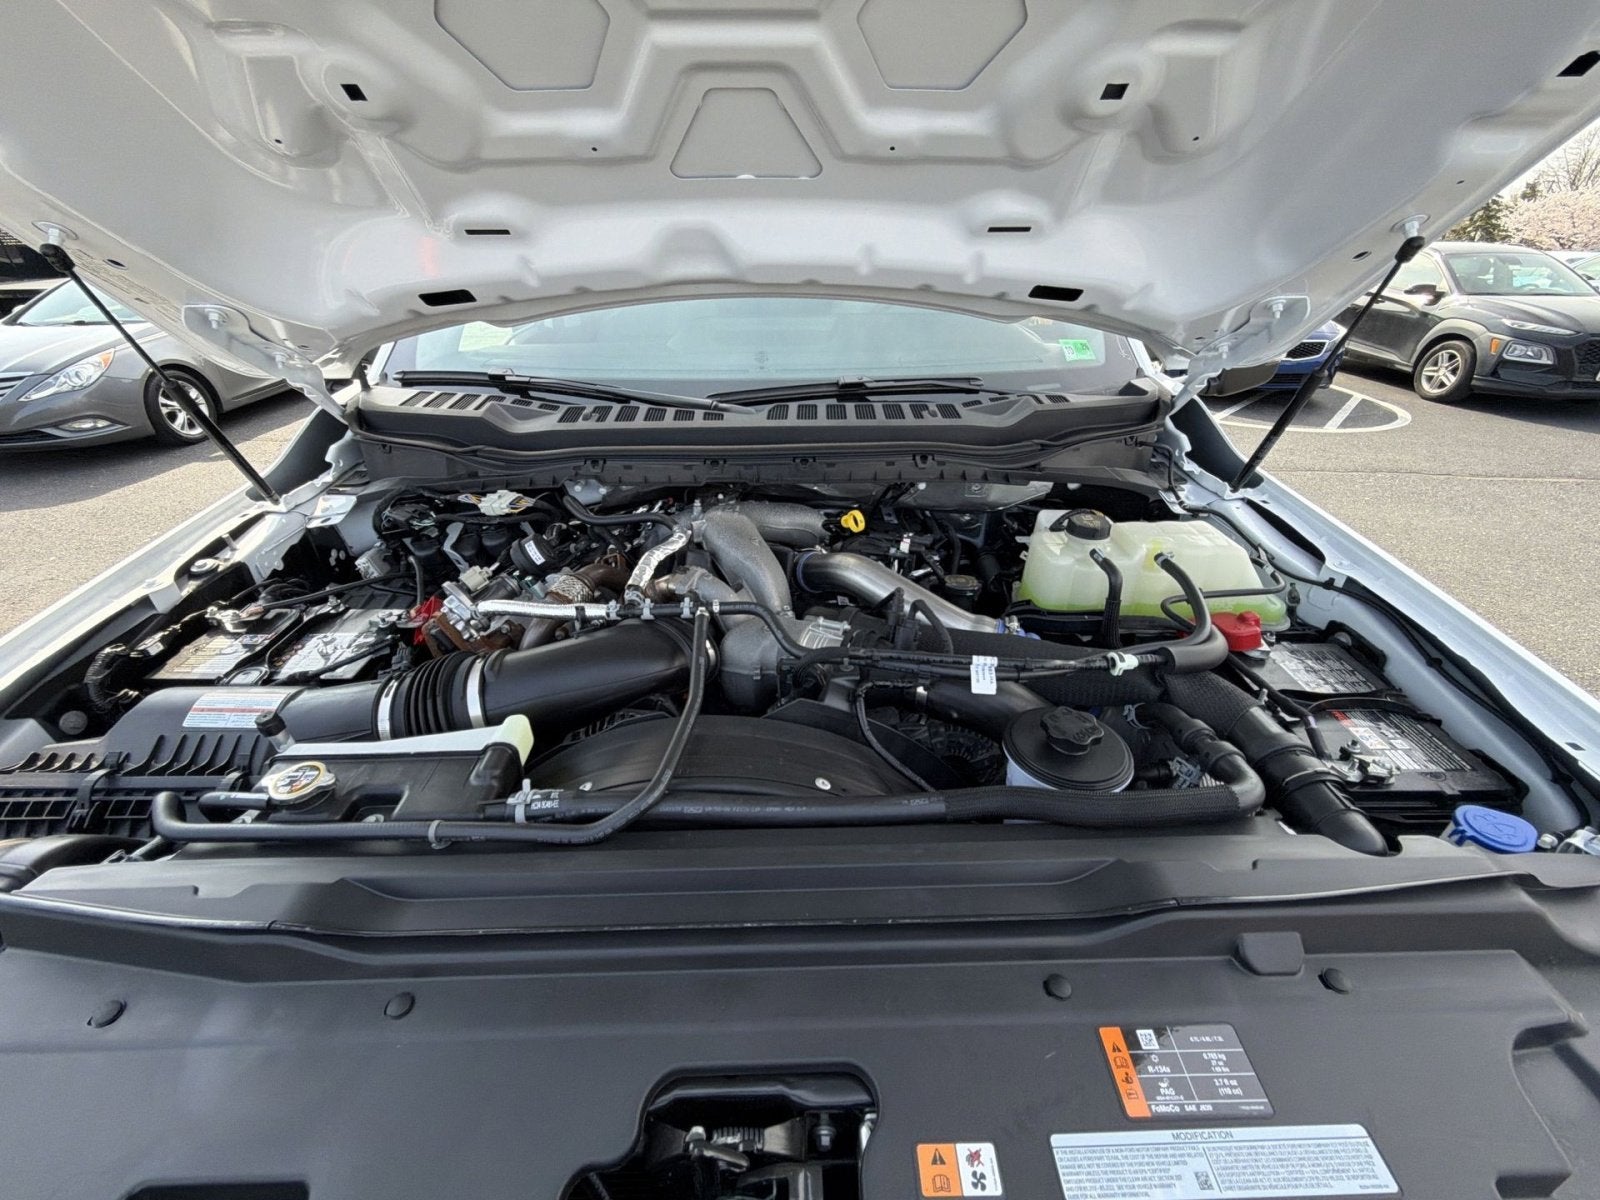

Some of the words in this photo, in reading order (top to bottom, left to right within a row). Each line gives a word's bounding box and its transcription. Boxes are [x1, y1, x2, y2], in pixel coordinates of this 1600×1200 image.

[1160, 1087, 1175, 1096] PAG
[1151, 1104, 1180, 1113] FoMoCo
[1171, 1130, 1234, 1141] MODIFICATION
